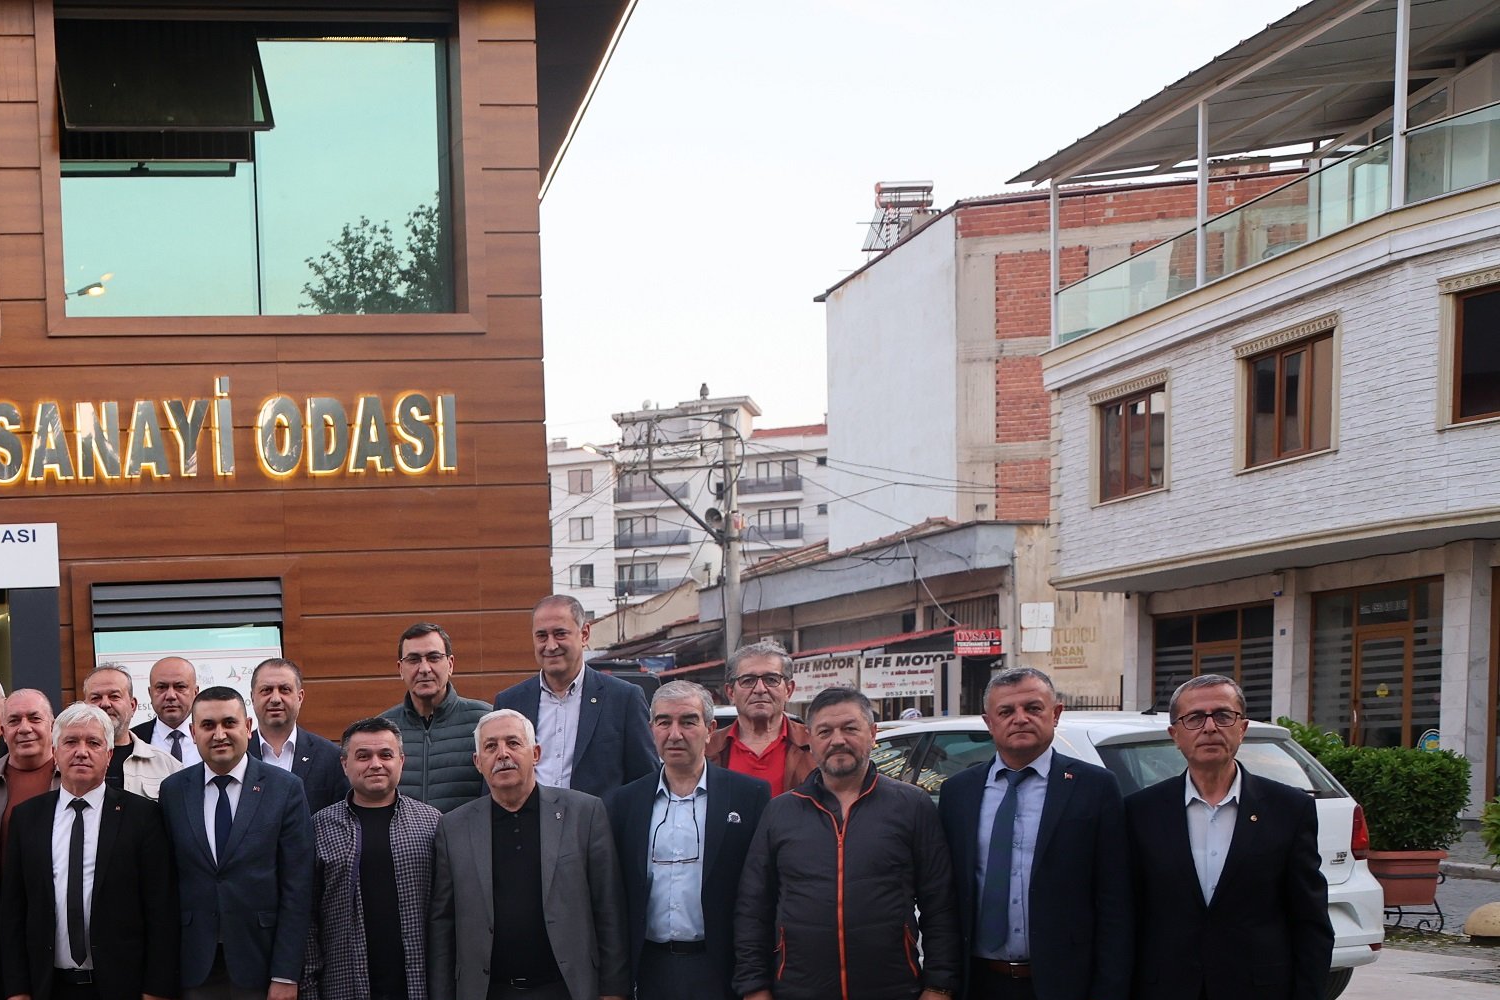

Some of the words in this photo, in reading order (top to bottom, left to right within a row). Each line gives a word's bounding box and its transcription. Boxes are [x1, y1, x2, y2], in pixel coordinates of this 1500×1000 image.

[257, 393, 457, 476] ODASI
[813, 657, 854, 672] MOTOR
[864, 656, 892, 669] EFE
